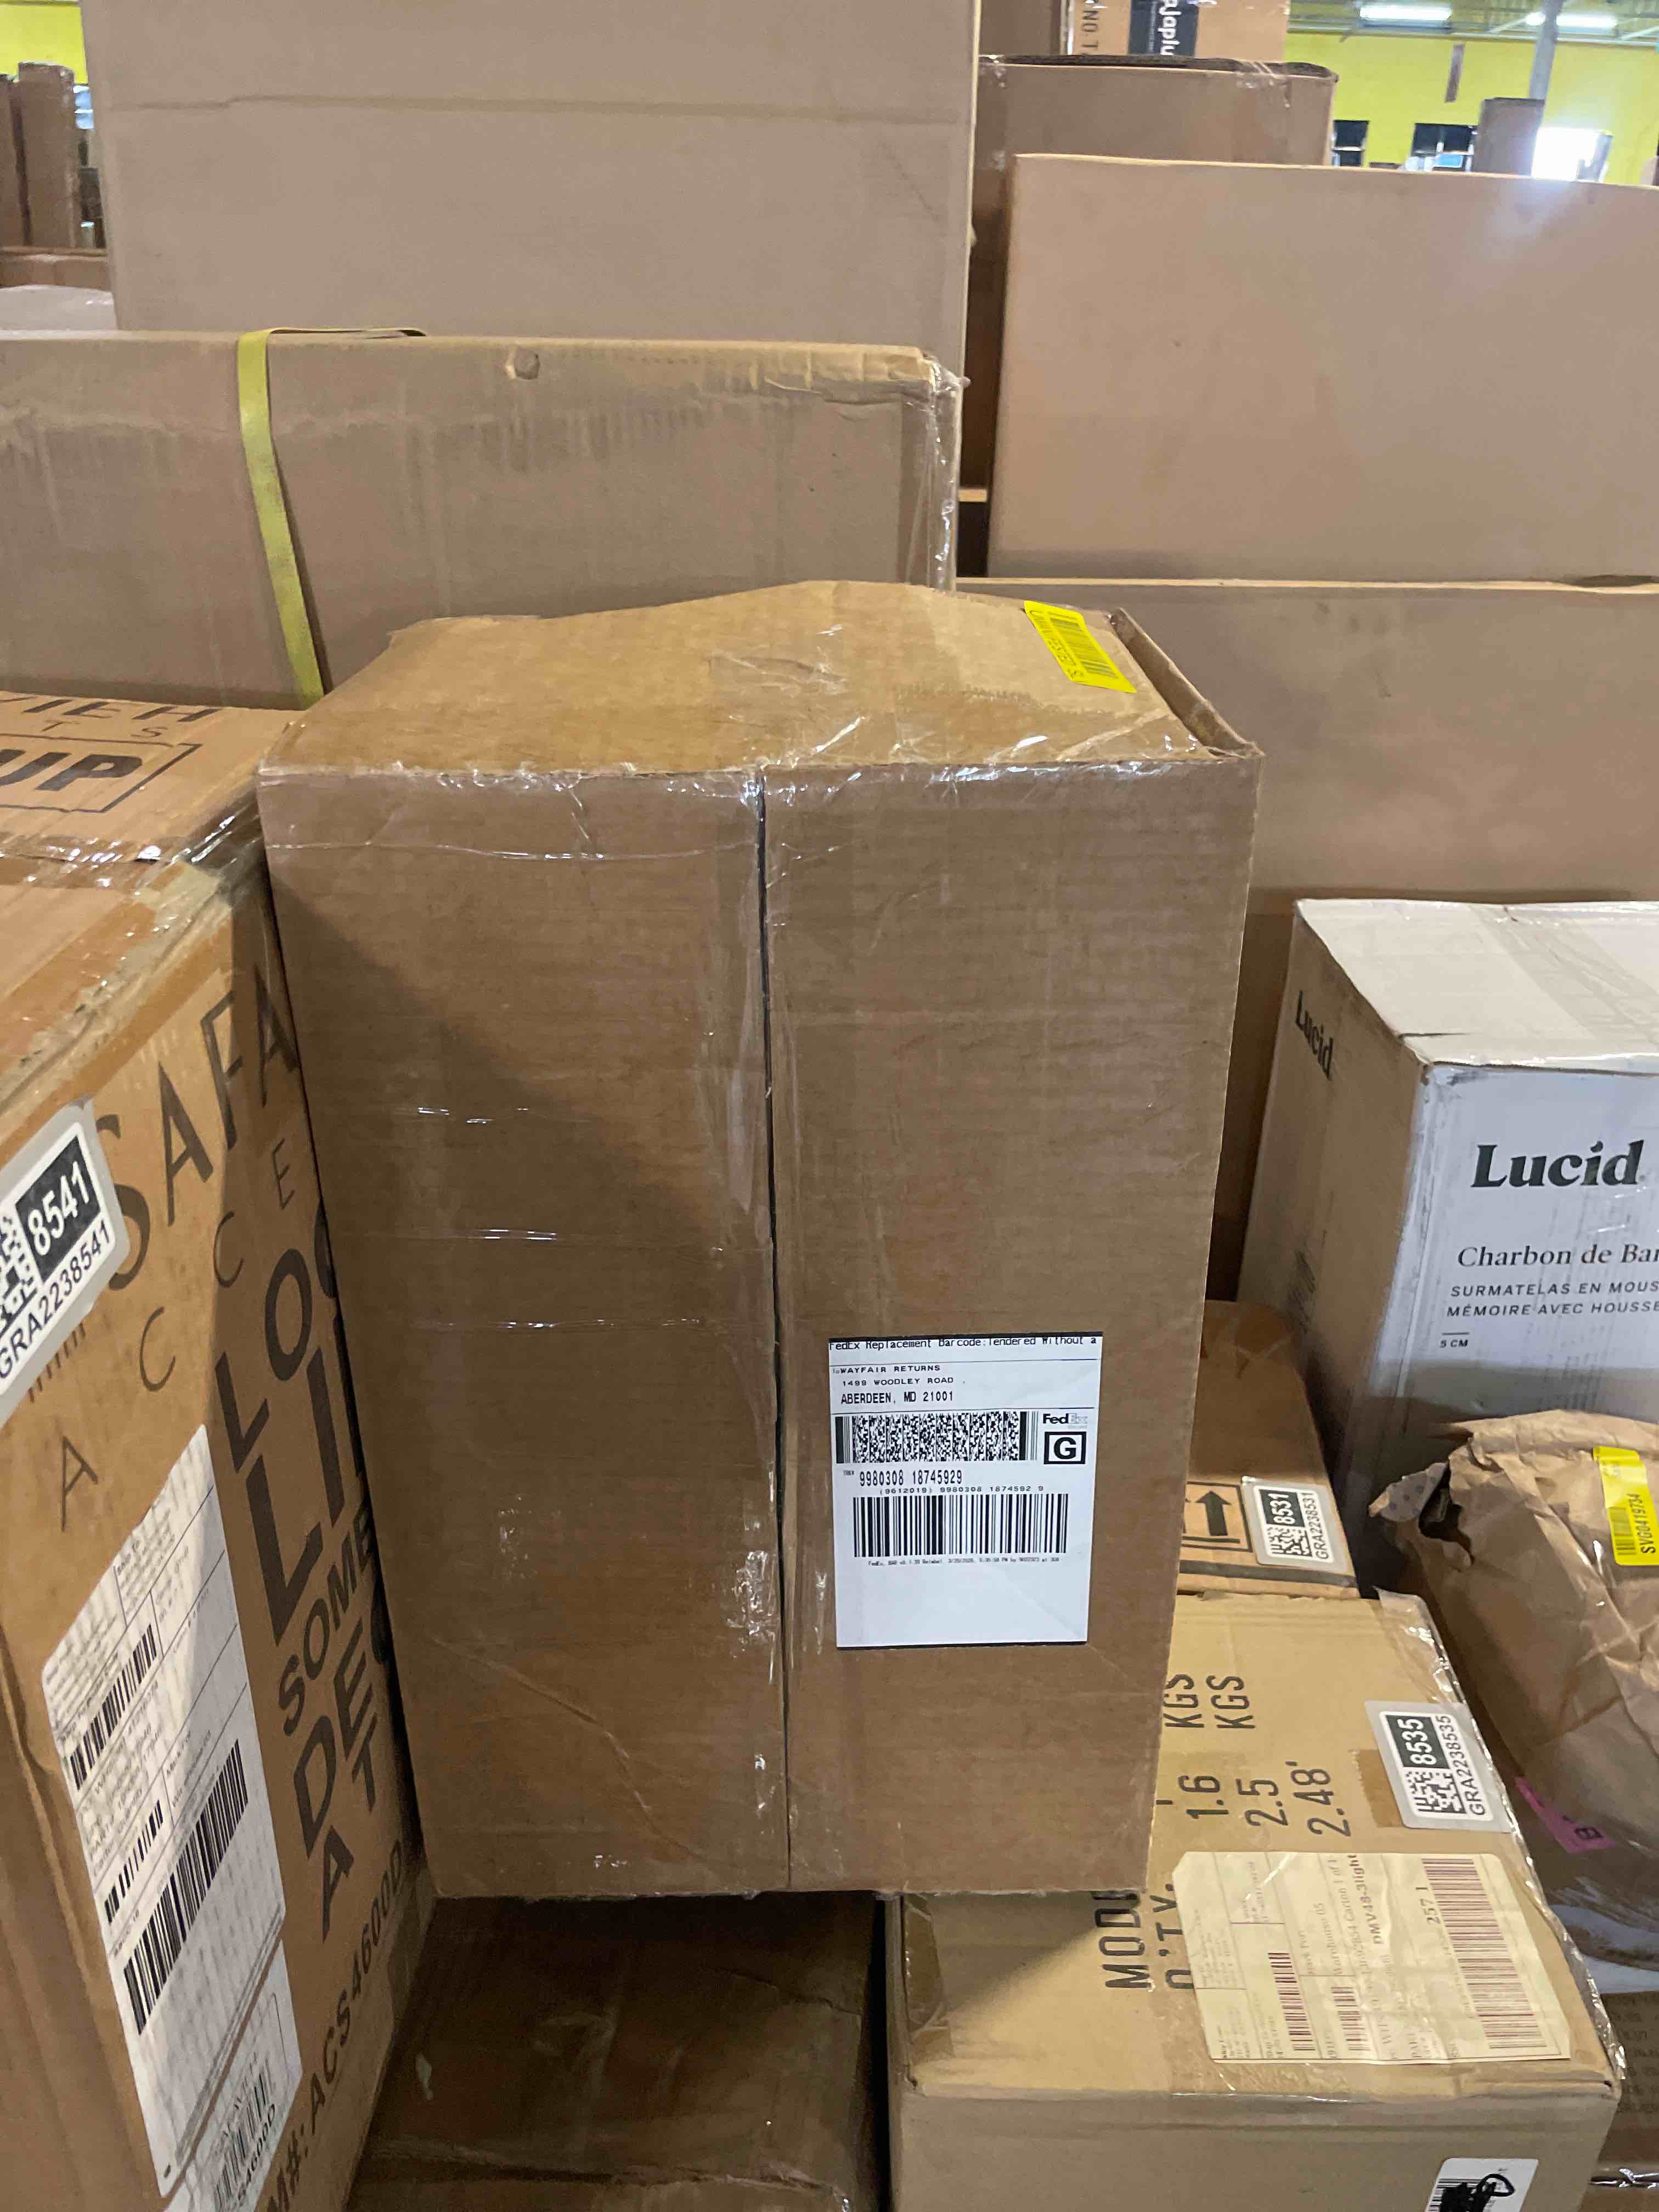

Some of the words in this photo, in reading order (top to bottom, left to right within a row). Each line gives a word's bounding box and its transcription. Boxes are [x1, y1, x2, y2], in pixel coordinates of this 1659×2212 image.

[1294, 990, 1334, 1081] Lucid
[1471, 1139, 1645, 1187] Lucid
[27, 1160, 89, 1256] 8541
[1458, 1245, 1572, 1267] Charbon
[1581, 1244, 1612, 1264] de
[0, 1219, 110, 1379] GRA2238541
[1447, 1304, 1531, 1317] MÉMOIRE
[1538, 1303, 1584, 1315] AVEC
[1451, 1283, 1571, 1297] SURMATELAS
[1578, 1282, 1601, 1294] EN
[866, 1339, 932, 1351] Replacement
[1450, 1339, 1469, 1347] CM
[841, 1392, 896, 1404] ABERDEEN,
[904, 1391, 917, 1402] MD
[923, 1390, 954, 1402] 21001
[874, 1378, 920, 1386] WOODLEY
[1053, 1436, 1077, 1460] G
[859, 1470, 904, 1487] 9980308
[913, 1469, 963, 1485] 18745929
[1267, 1492, 1296, 1525] 8531
[1301, 1492, 1329, 1560] GRA2238531
[1163, 1673, 1205, 1729] KGS
[1205, 1674, 1256, 1729] KGS
[1397, 1718, 1438, 1765] 8535
[1435, 1714, 1486, 1816] GRA2238535
[1178, 1774, 1229, 1819] 1.6
[1236, 1779, 1289, 1827] 2.5
